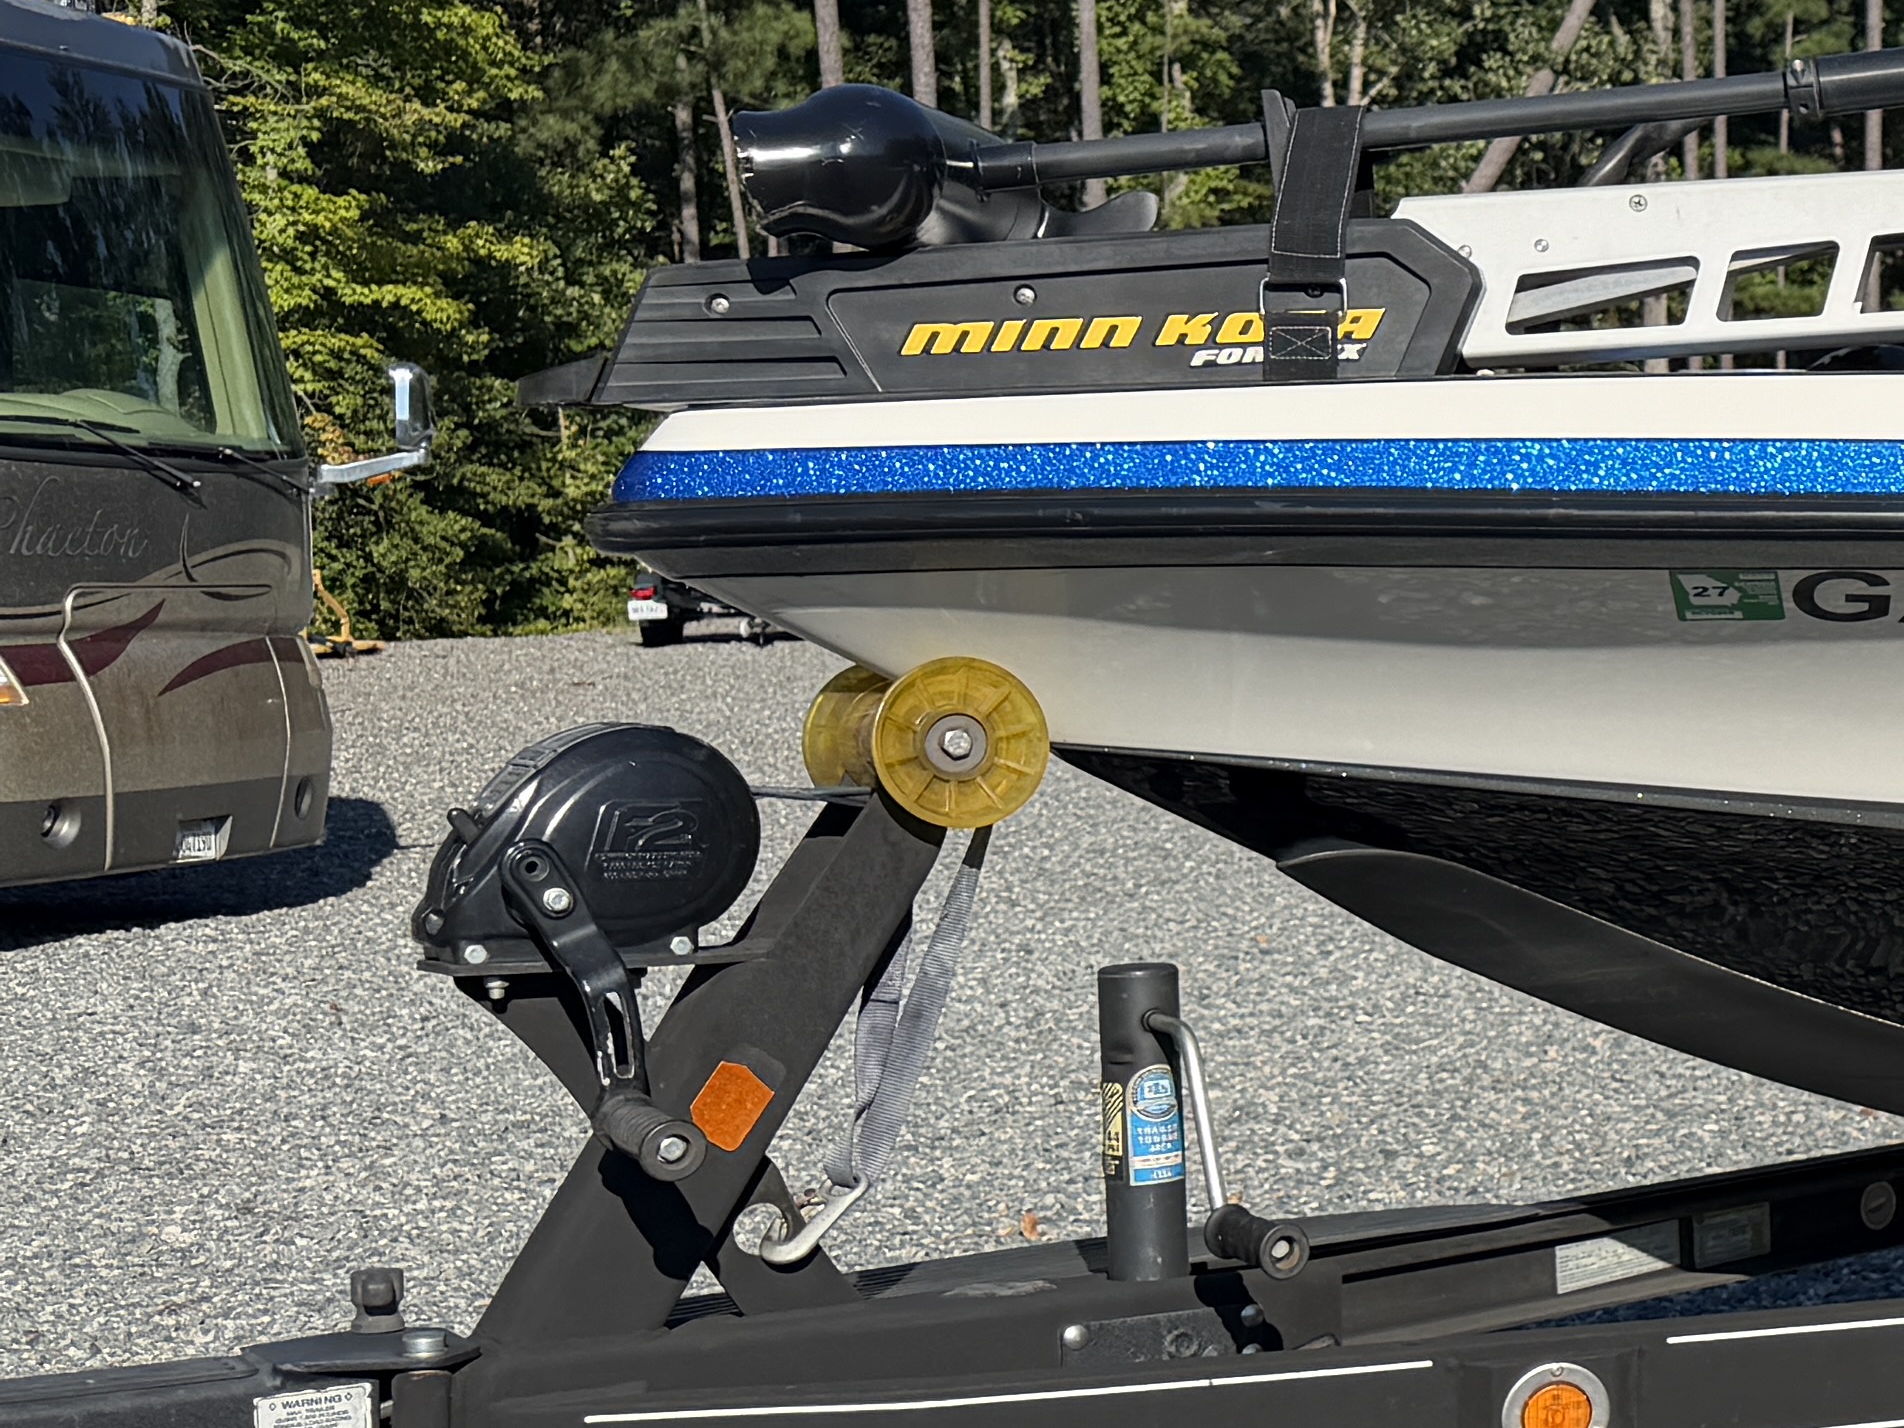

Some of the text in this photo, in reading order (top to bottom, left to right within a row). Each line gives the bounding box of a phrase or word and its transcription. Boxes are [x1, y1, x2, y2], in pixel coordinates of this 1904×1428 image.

[900, 307, 1387, 357] MINN KOA
[1189, 343, 1367, 367] FORX
[1691, 585, 1730, 598] 27
[281, 1394, 342, 1410] WARNING
